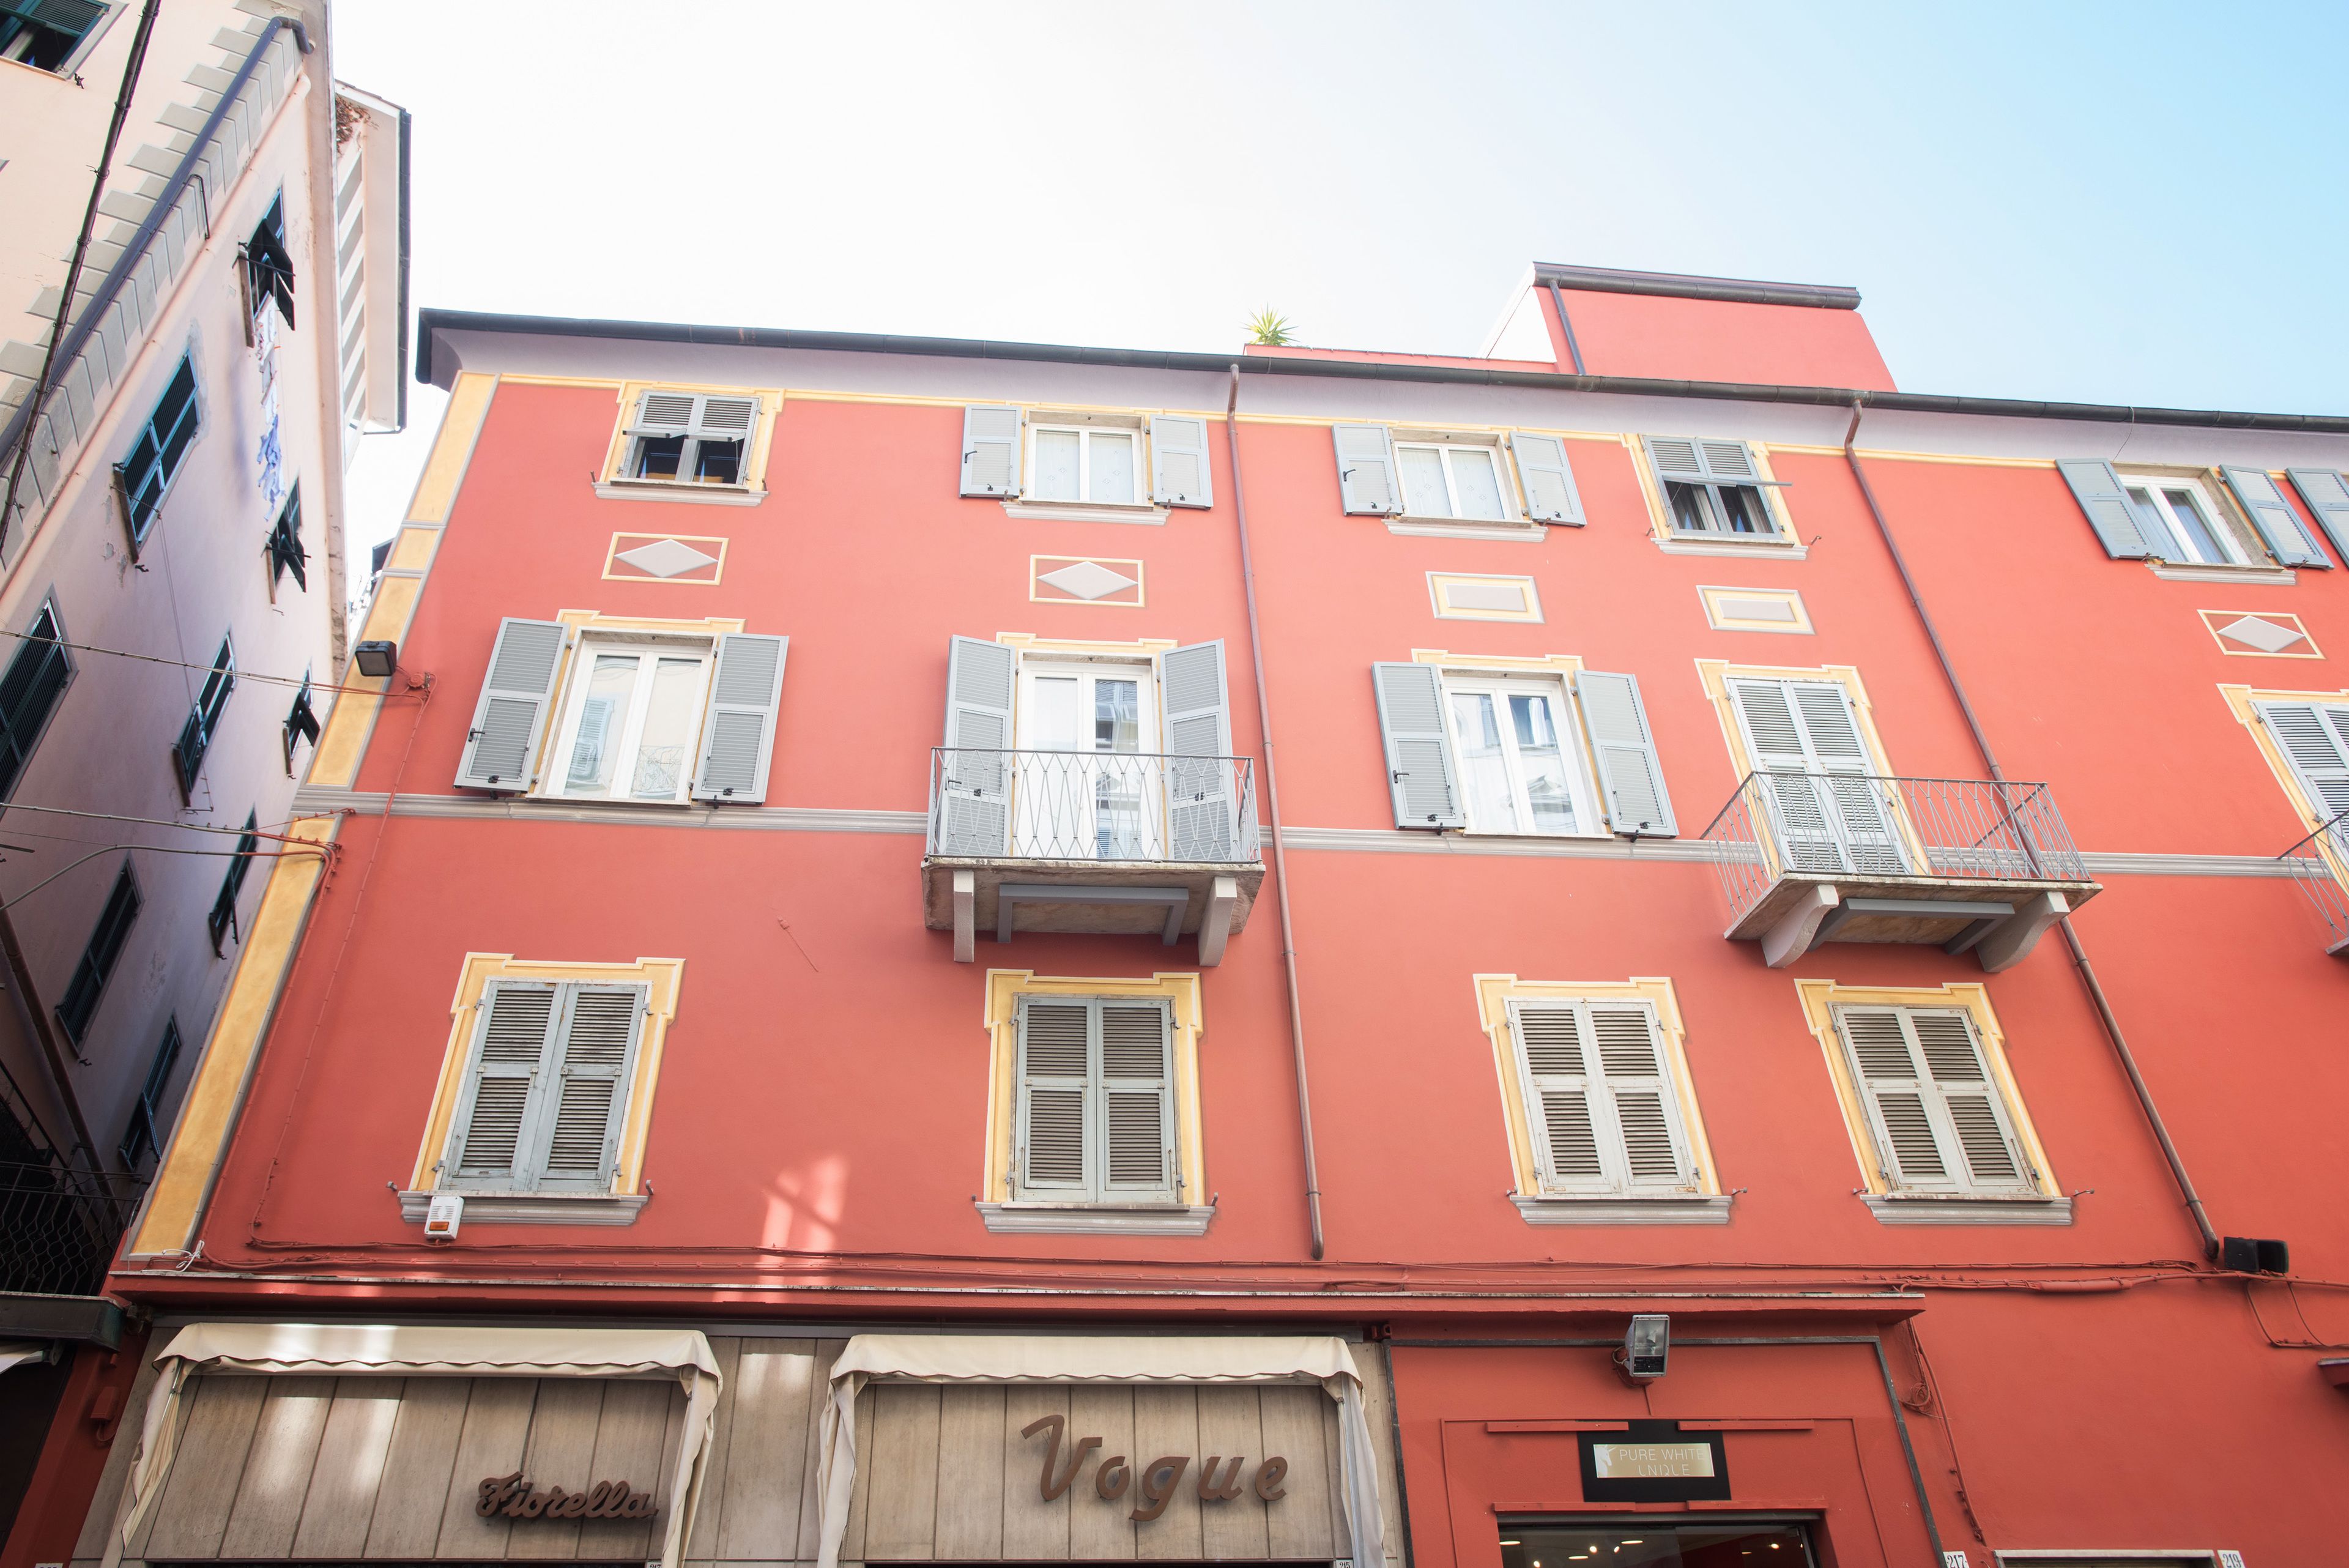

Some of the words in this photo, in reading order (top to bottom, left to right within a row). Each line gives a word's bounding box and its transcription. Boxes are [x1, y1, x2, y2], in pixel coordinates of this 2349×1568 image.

[1619, 1448, 1657, 1461] PURE
[1661, 1448, 1705, 1461] WHITE
[1021, 1414, 1288, 1522] Vogue
[475, 1471, 659, 1519] Fiorella
[1946, 1555, 1965, 1568] 217
[2222, 1553, 2242, 1568] 219
